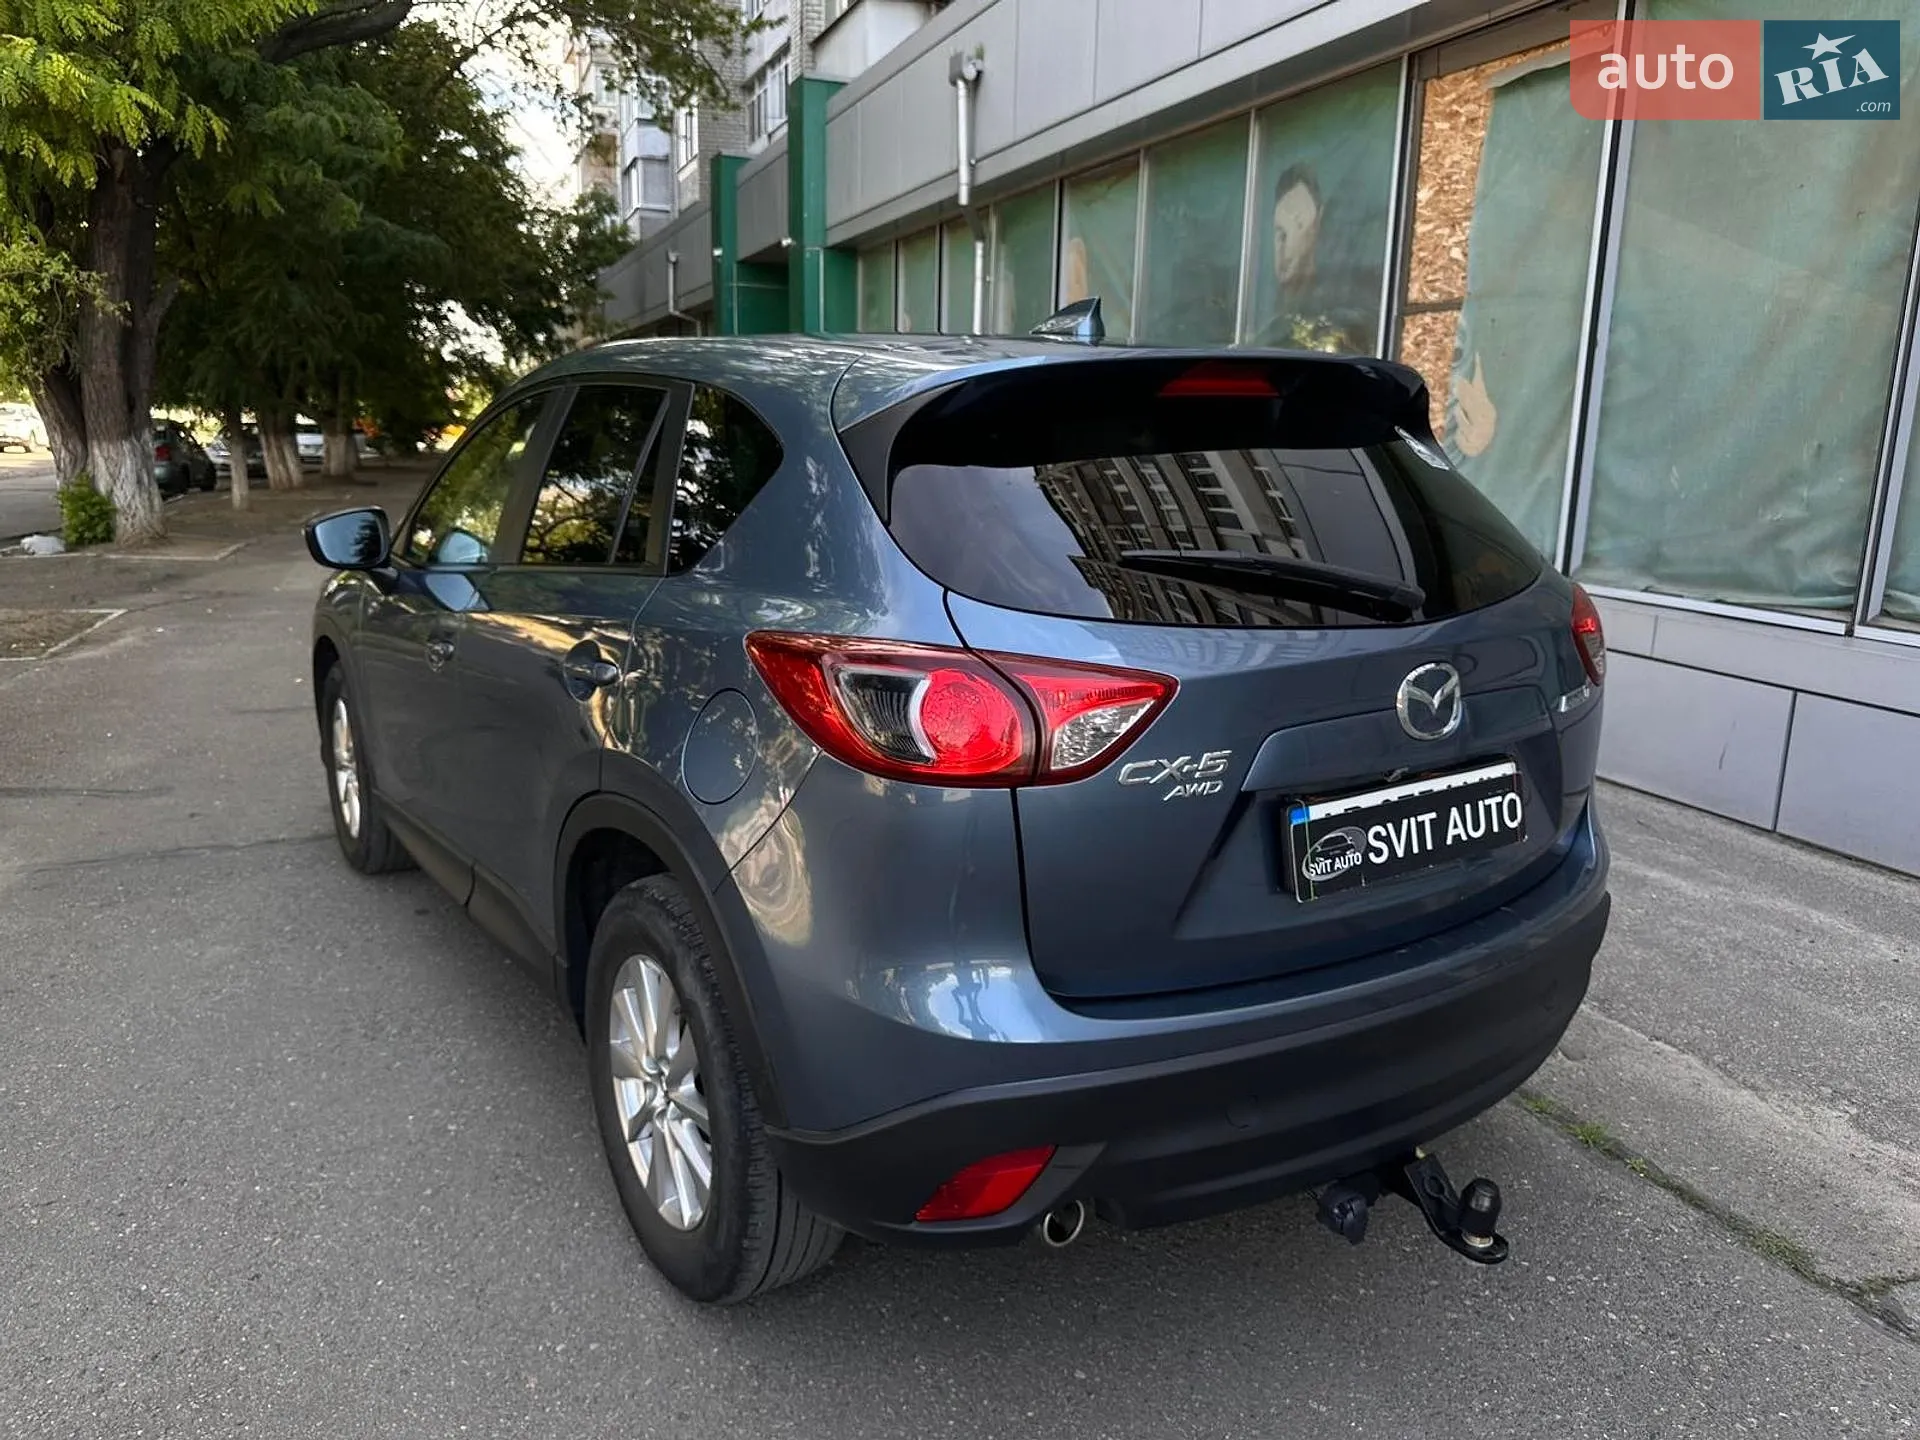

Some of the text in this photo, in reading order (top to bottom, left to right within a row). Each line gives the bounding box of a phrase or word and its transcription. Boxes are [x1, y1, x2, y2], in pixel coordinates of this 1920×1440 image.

[1118, 750, 1232, 785] CX-5
[1163, 780, 1223, 801] AWD
[1367, 811, 1438, 865] SVIT
[1446, 792, 1523, 846] AUTO
[1309, 852, 1362, 876] SVIT AUTO
